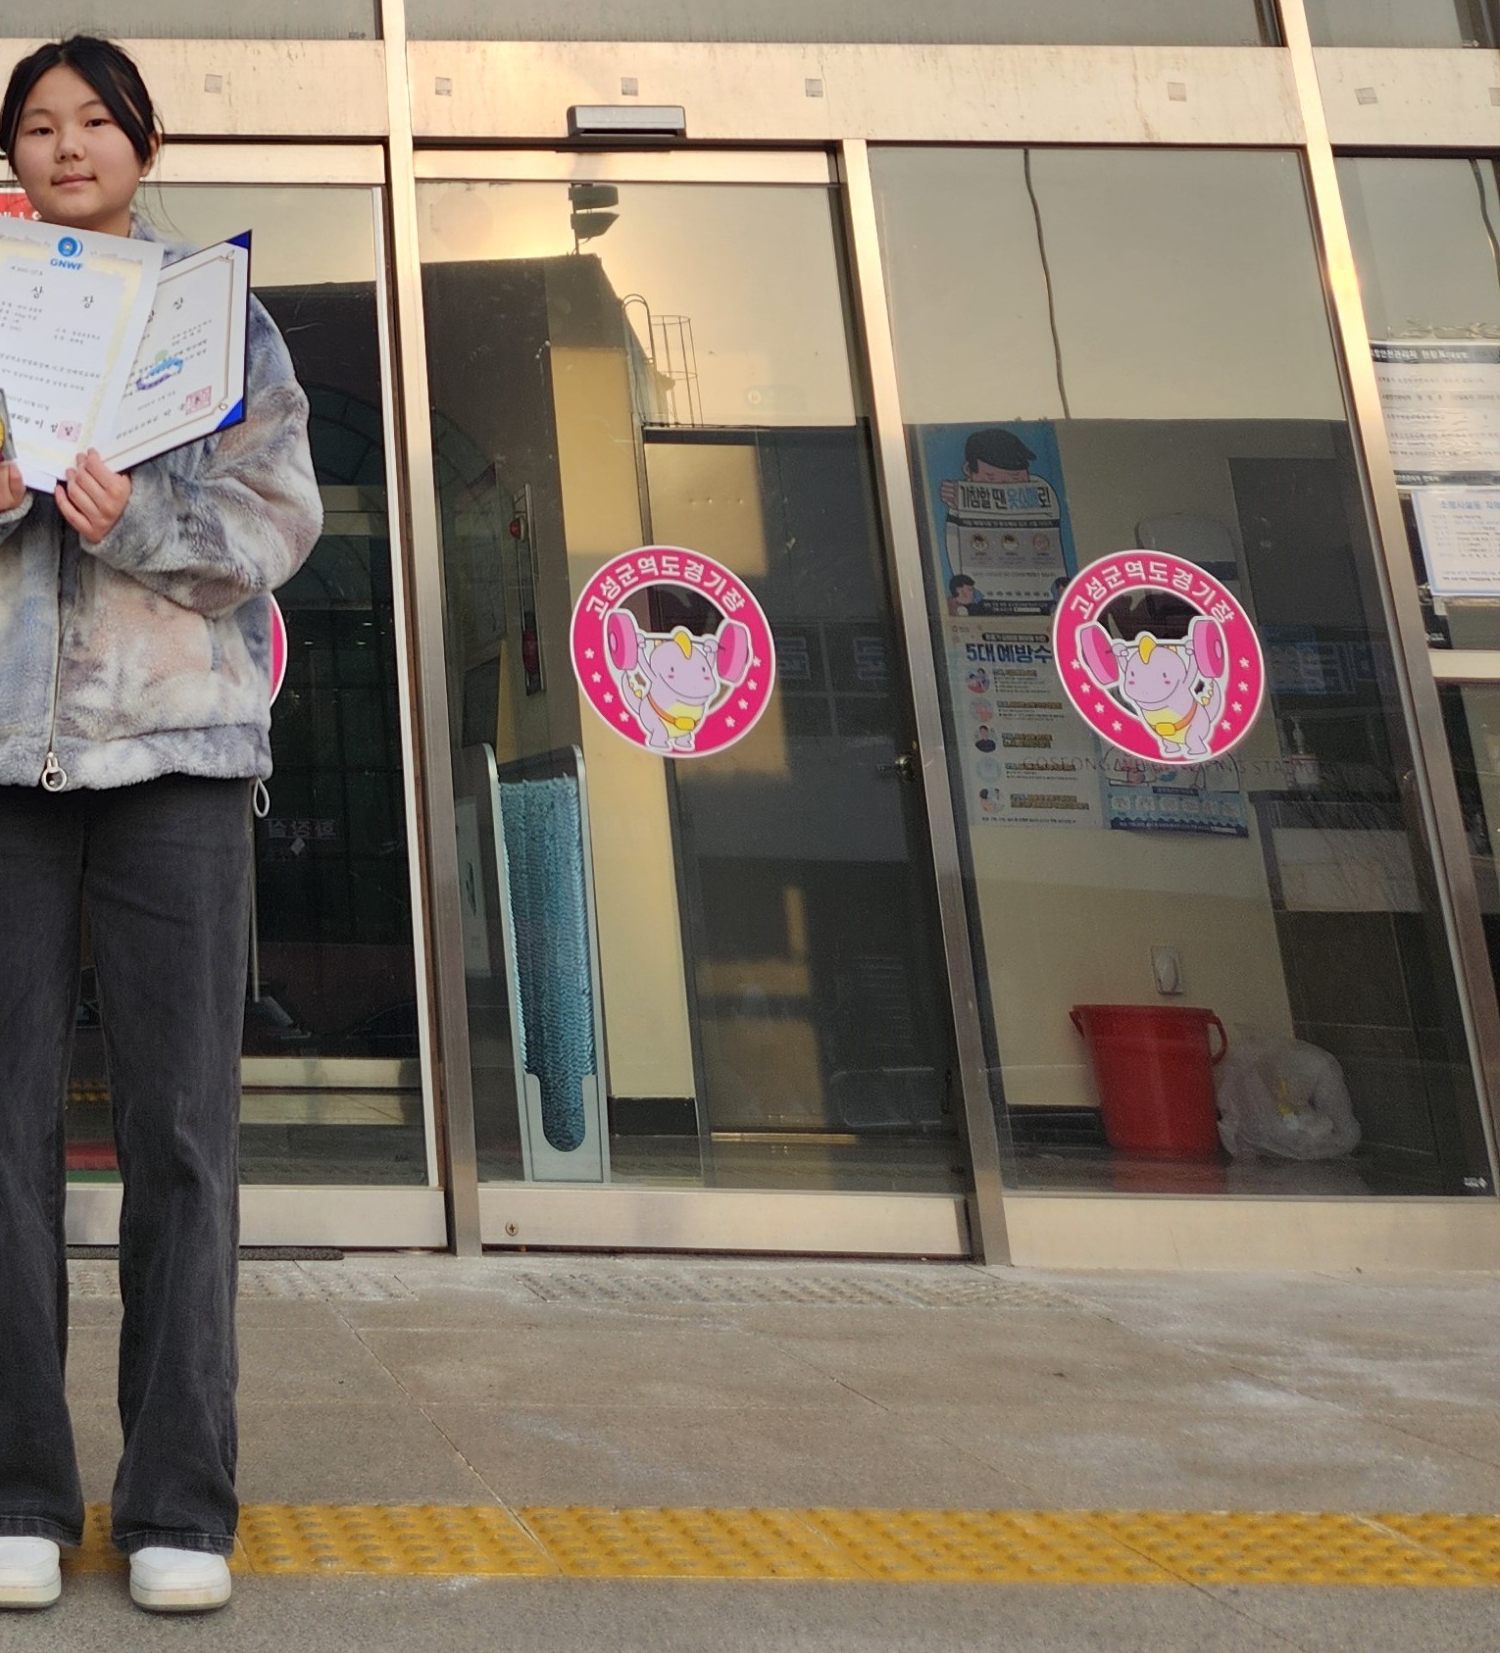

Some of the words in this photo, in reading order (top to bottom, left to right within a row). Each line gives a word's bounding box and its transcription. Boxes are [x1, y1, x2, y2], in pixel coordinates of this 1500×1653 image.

[49, 257, 85, 272] GNWF
[30, 285, 45, 300] 상
[585, 554, 746, 621] 고성군역도경기장
[1069, 559, 1236, 625] 고성군역도경기장
[996, 643, 1053, 664] 예방수
